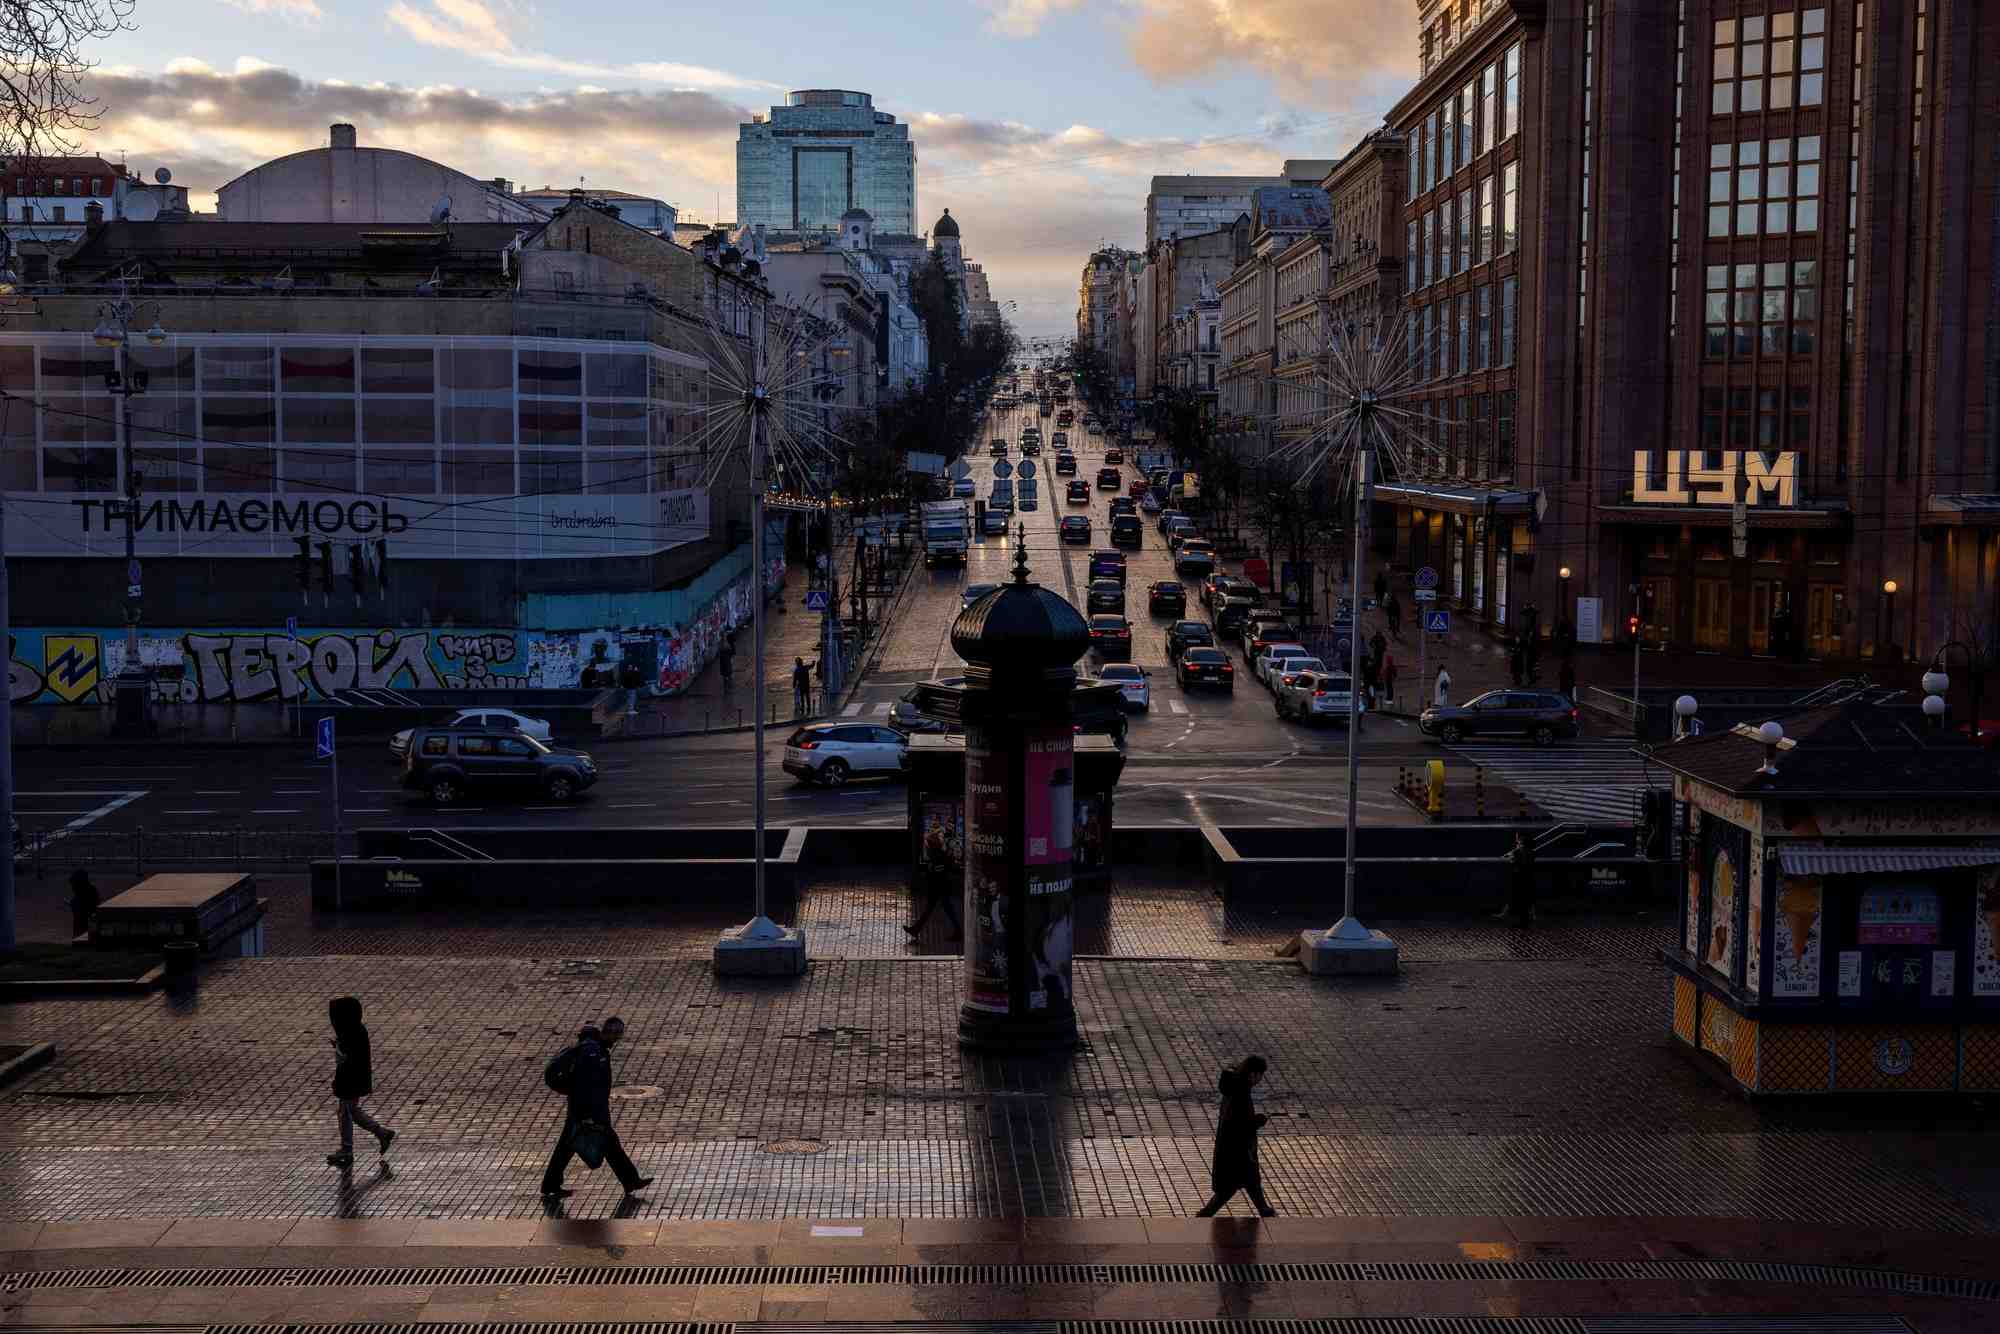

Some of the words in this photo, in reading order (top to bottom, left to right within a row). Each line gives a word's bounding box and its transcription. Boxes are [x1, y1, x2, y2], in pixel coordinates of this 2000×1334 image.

[1633, 449, 1797, 506] ЦУМ
[72, 499, 408, 533] ТРИМАЄМОСЬ
[437, 634, 516, 664] КИЇВ
